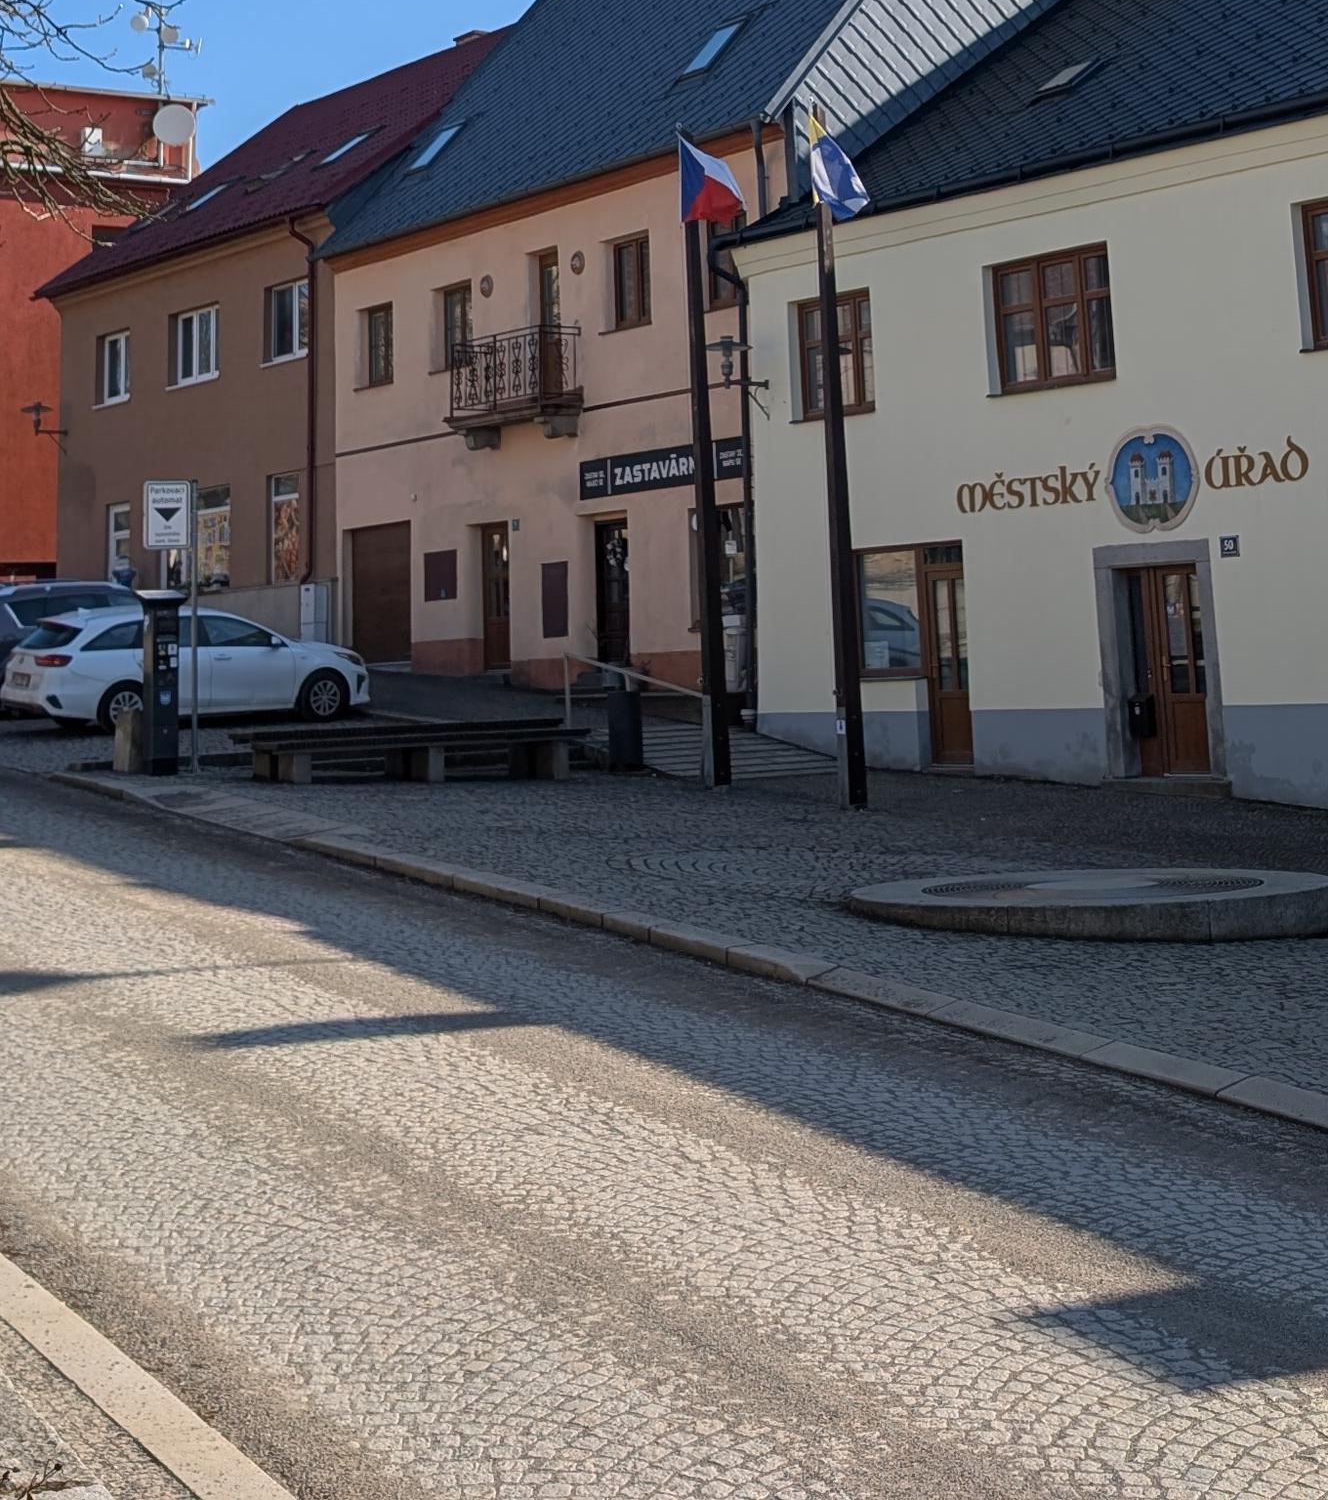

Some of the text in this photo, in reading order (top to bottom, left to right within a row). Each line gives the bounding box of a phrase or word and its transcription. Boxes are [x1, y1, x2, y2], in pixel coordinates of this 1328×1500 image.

[613, 453, 696, 486] ZASTAVÁRN
[956, 435, 1310, 514] MĚSTSKÝ ÚŘAD
[1224, 539, 1234, 550] 50
